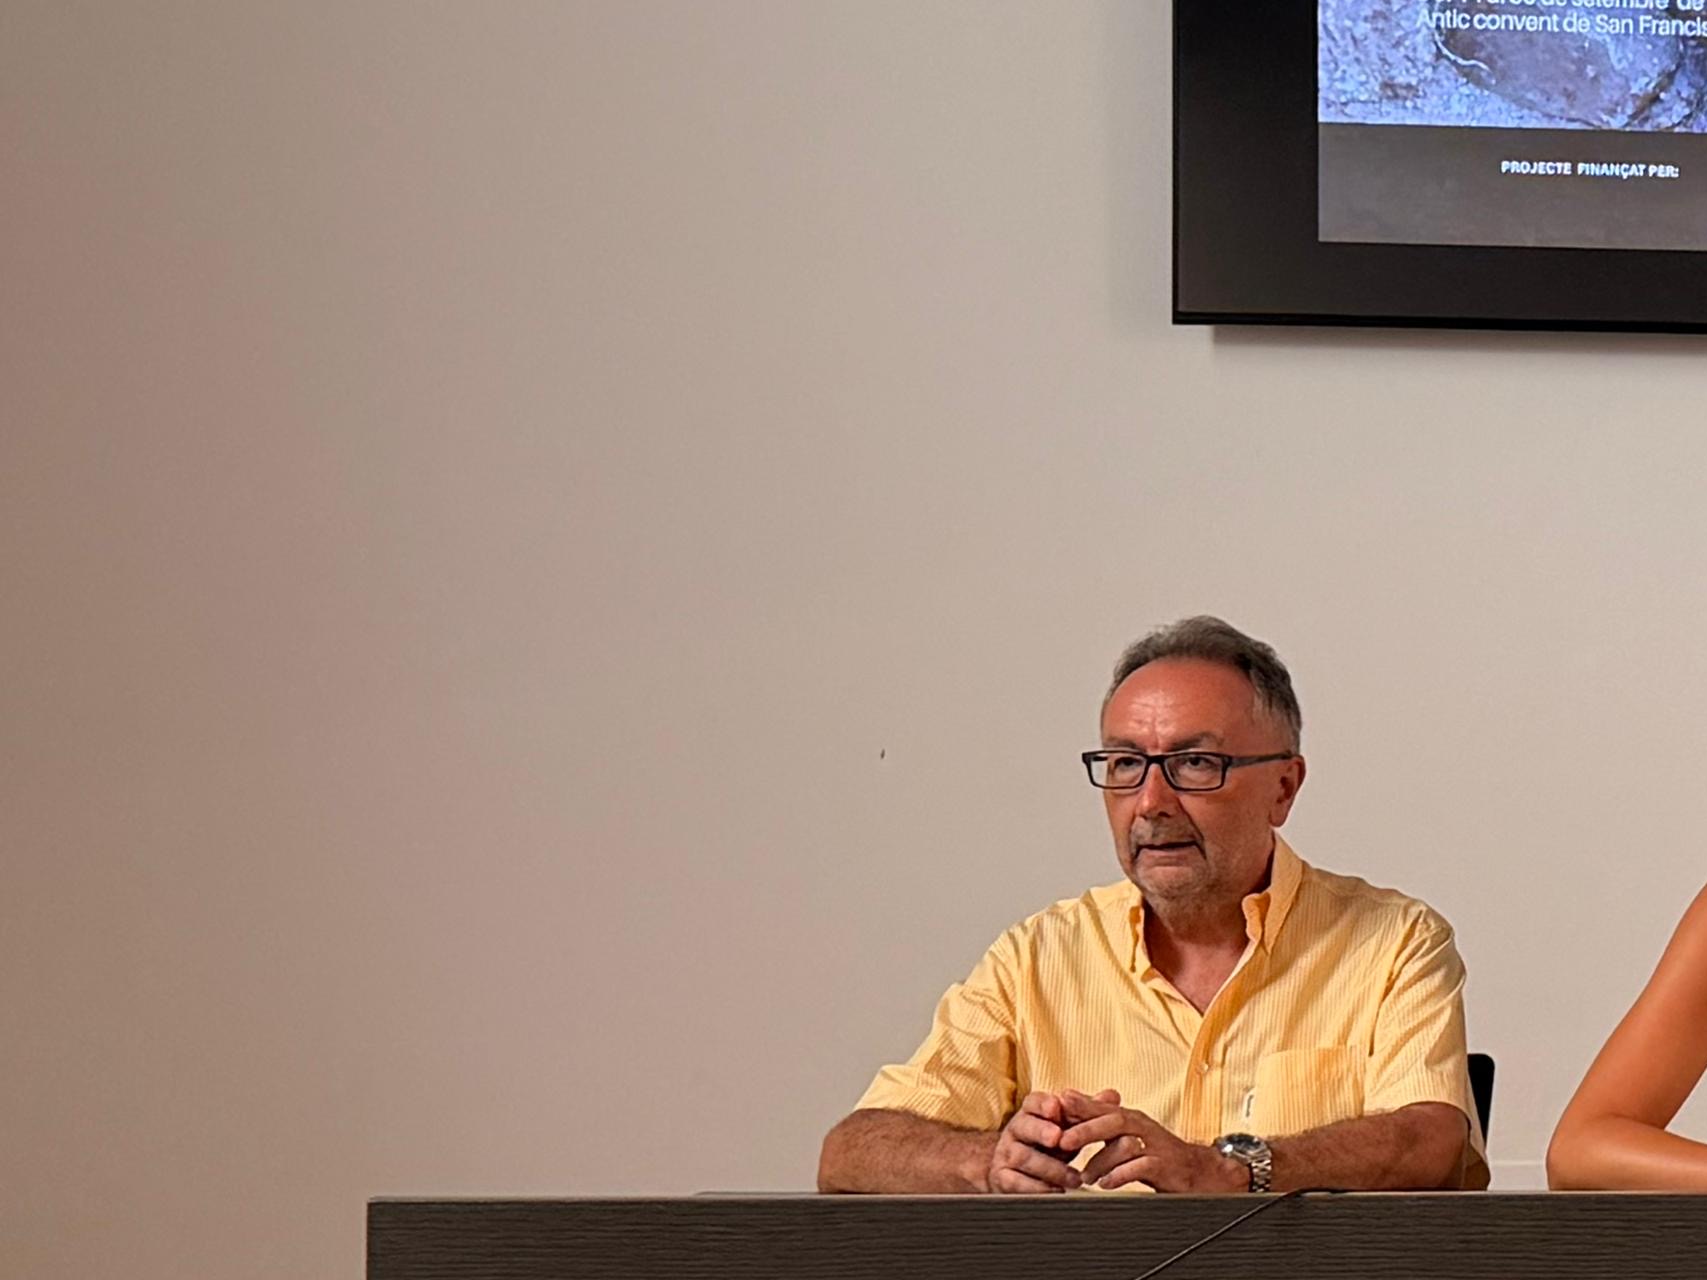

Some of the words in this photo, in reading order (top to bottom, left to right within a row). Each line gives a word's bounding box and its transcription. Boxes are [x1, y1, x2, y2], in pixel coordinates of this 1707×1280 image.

[1417, 9, 1471, 30] Antic
[1473, 14, 1559, 32] convent
[1563, 13, 1590, 33] de
[1595, 15, 1633, 35] San
[1501, 161, 1572, 175] PROJECTE
[1577, 163, 1646, 180] FINANÇAT
[1648, 164, 1680, 178] PER:
